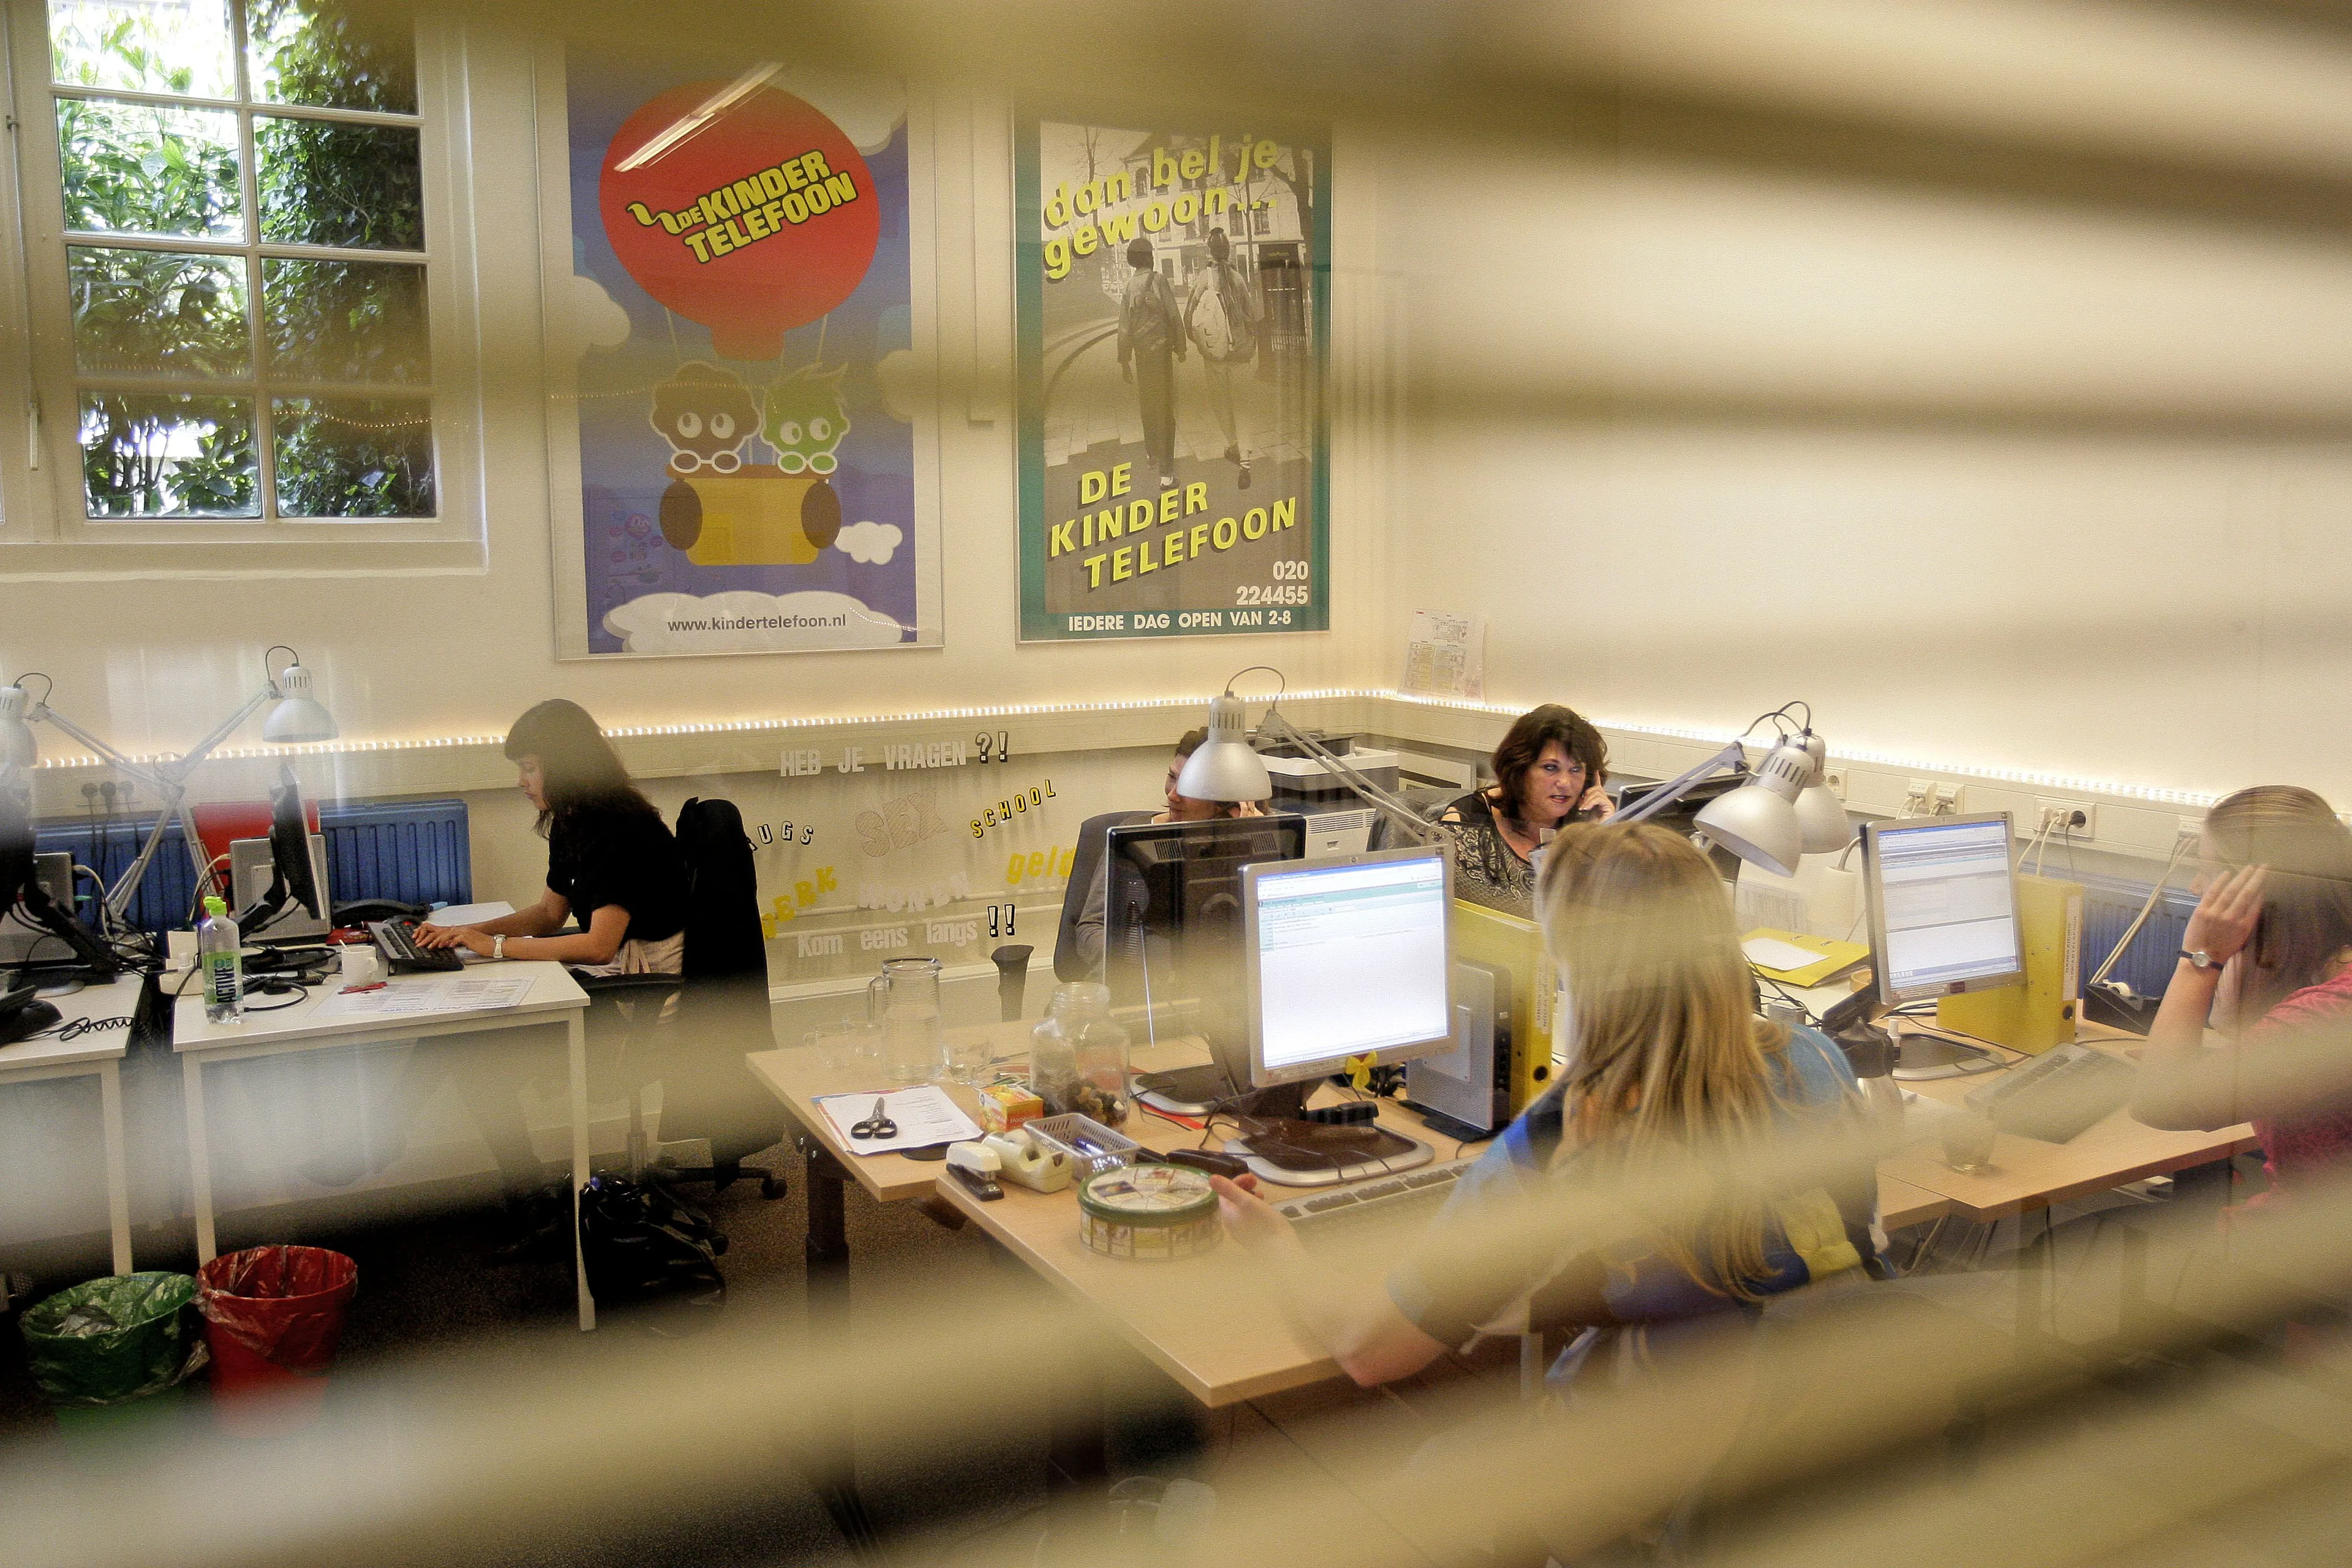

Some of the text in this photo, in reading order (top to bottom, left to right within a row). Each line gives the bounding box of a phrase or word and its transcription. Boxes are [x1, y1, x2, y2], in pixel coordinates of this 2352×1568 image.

[677, 150, 831, 230] DE KINDER
[1046, 133, 1278, 227] dan bel je
[685, 172, 858, 263] TELEFOON
[1044, 186, 1277, 280] gewoon...
[1080, 462, 1132, 505] DE
[1050, 481, 1208, 558] KINDER
[1083, 496, 1297, 589] TELEFOON
[1236, 586, 1309, 606] 224455
[1273, 560, 1309, 581] 020
[668, 614, 846, 632] www.kindertelefoon.nl
[1068, 610, 1291, 632] IEDERE DAG OPEN VAN 2-8
[780, 749, 821, 777] HEB
[837, 746, 865, 774] JE
[883, 741, 967, 771] VRAGEN
[855, 786, 951, 858] SEX
[970, 779, 1056, 839] SCHOOL
[861, 927, 908, 950] eens
[925, 919, 978, 947] langs
[987, 903, 1015, 938] !!
[214, 967, 237, 1003] ACTIVE
